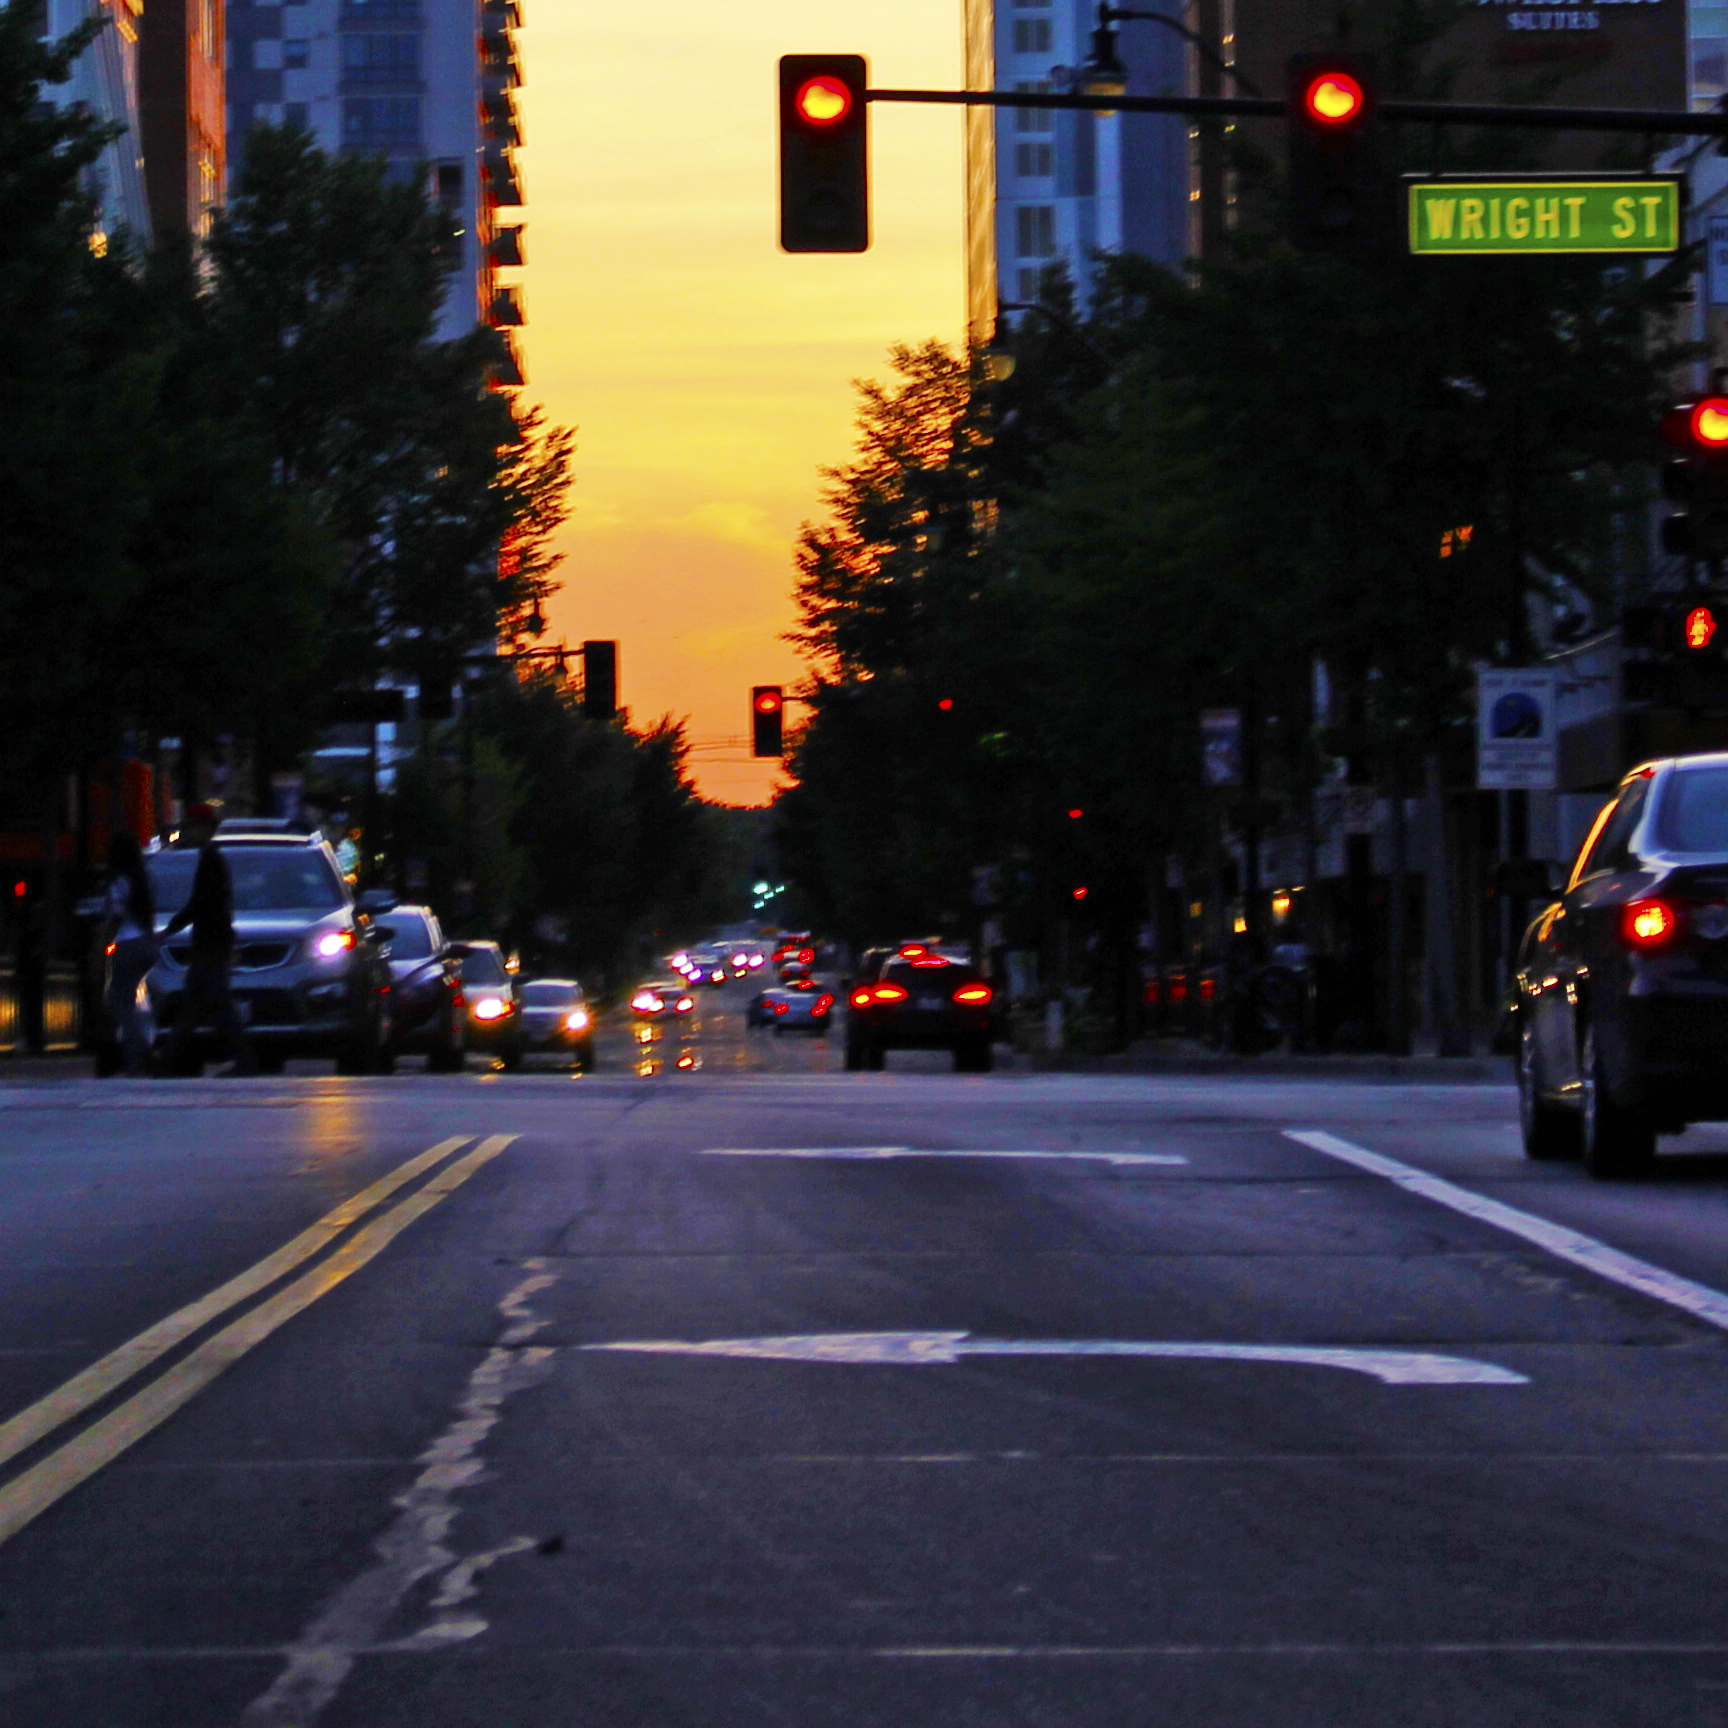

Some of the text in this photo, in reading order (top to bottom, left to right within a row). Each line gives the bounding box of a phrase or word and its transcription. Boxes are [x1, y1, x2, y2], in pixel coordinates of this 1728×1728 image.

[1506, 9, 1601, 32] SUITES
[1425, 195, 1663, 239] WRIGHT ST
